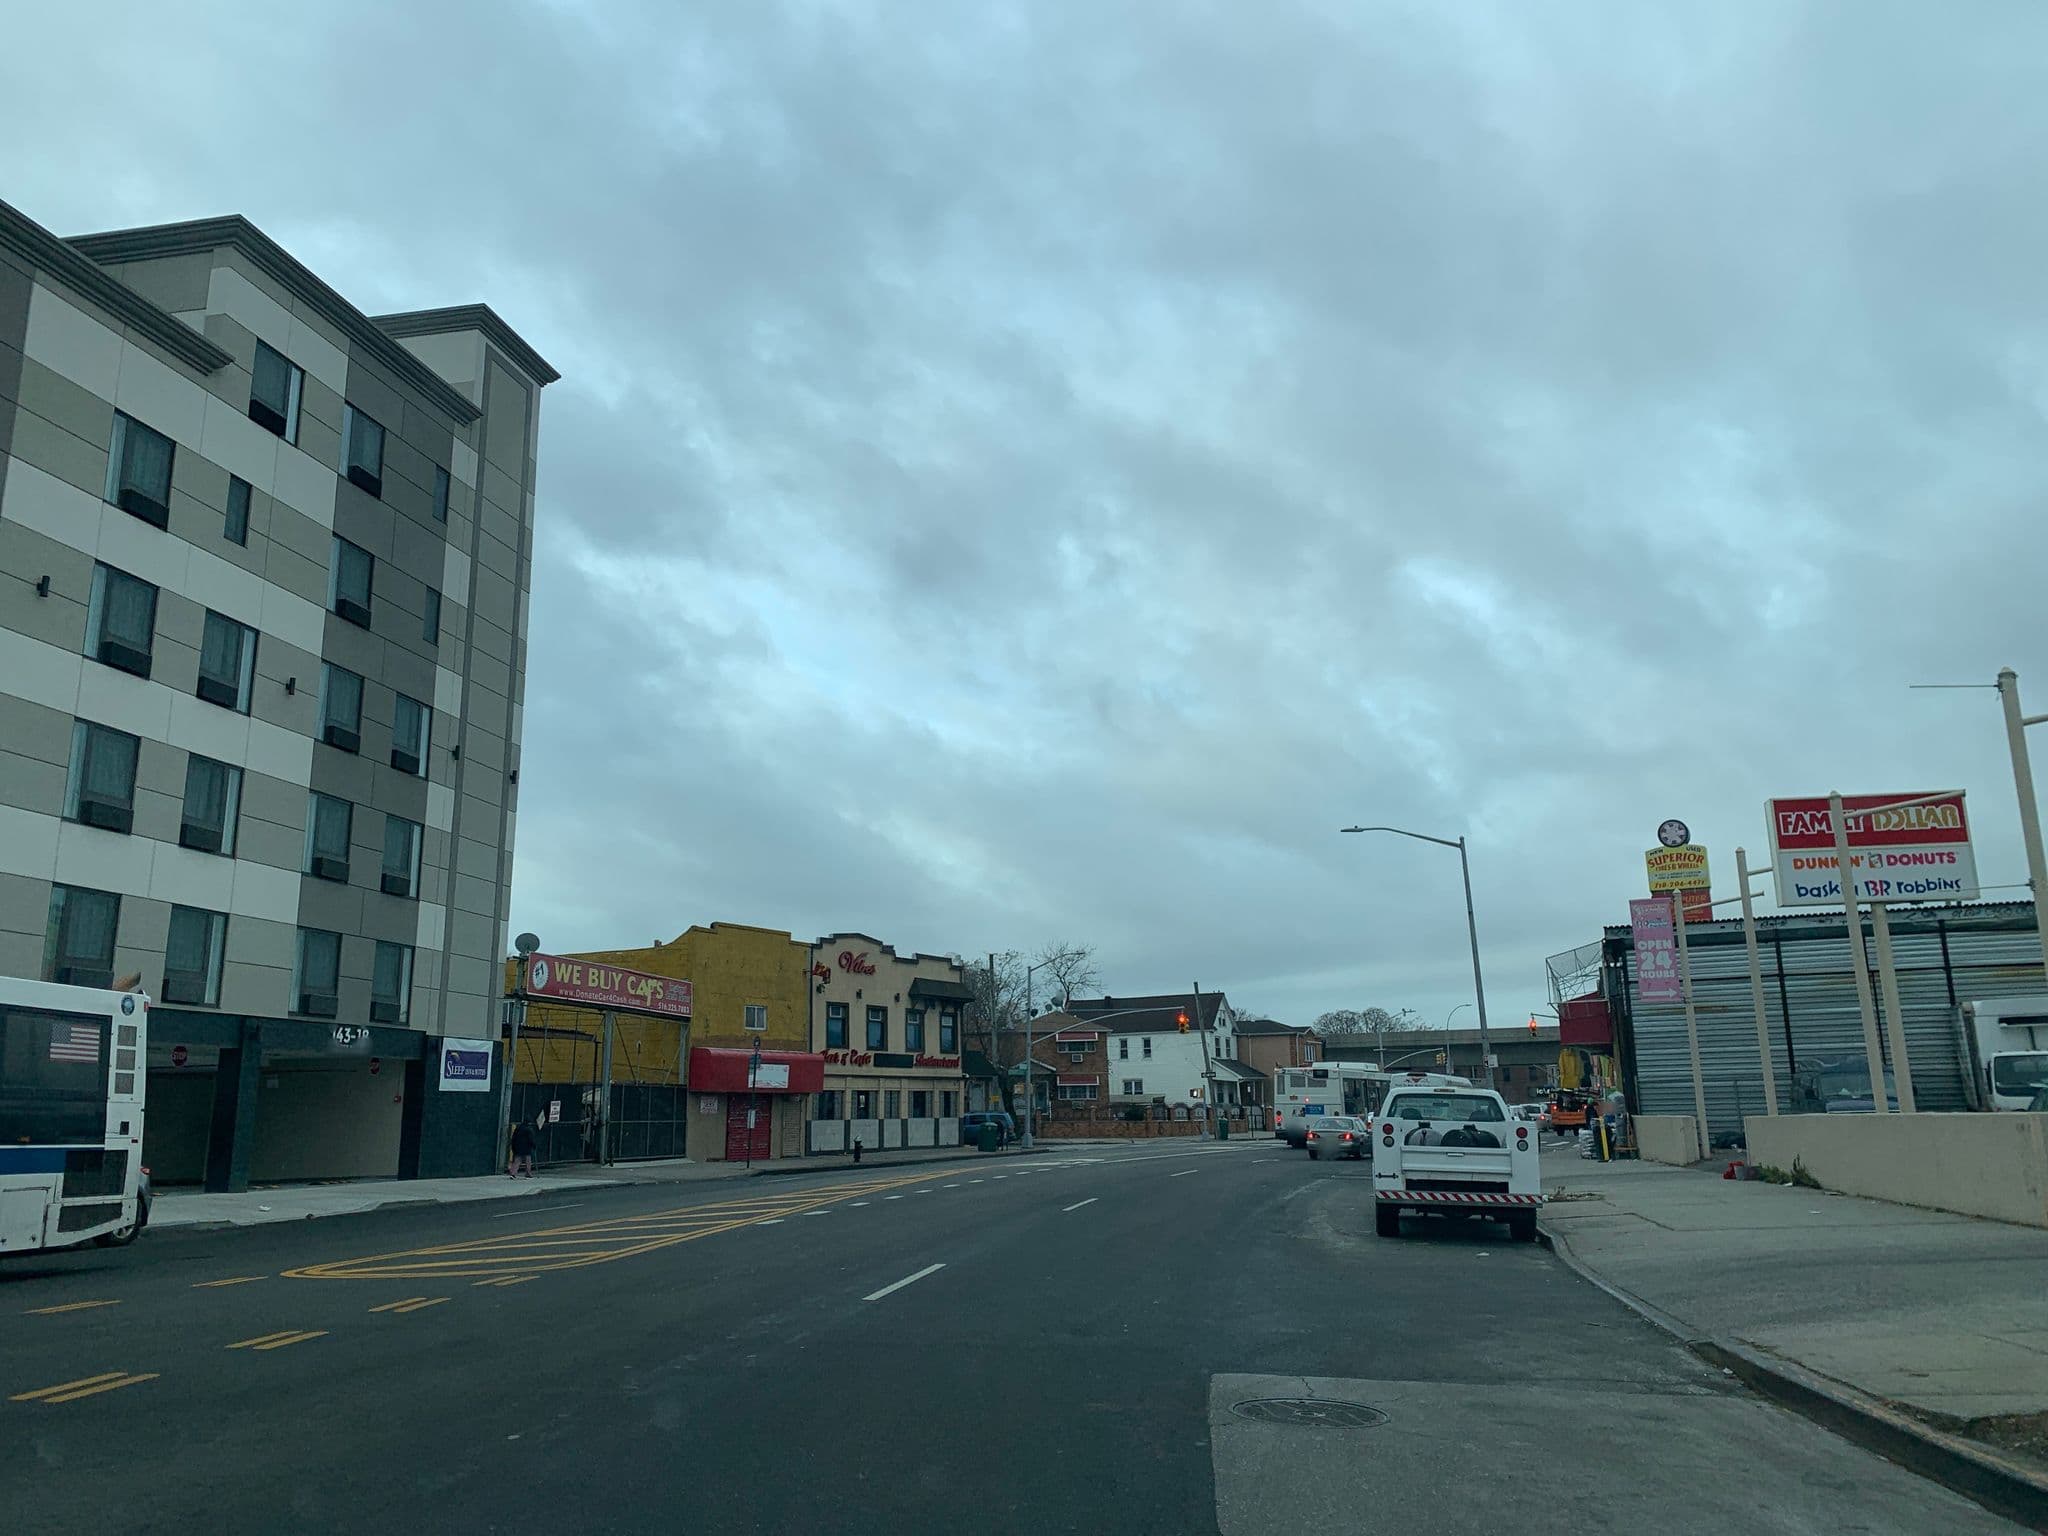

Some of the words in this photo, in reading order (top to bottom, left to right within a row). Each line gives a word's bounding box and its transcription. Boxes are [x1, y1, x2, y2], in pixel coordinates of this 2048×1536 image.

[1780, 811, 1864, 836] FAMLY
[1872, 805, 1961, 831] DOLLAR
[1648, 852, 1705, 868] SUPERIOR
[1793, 855, 1864, 870] DUNKN'
[1886, 852, 1957, 866] DONUTS
[1795, 881, 1859, 898] bask
[1897, 878, 1962, 895] robbins
[1638, 940, 1672, 950] OPEN
[1641, 950, 1673, 970] 24
[554, 961, 582, 986] WE
[588, 968, 623, 992] BUY
[1640, 969, 1675, 979] HOURS
